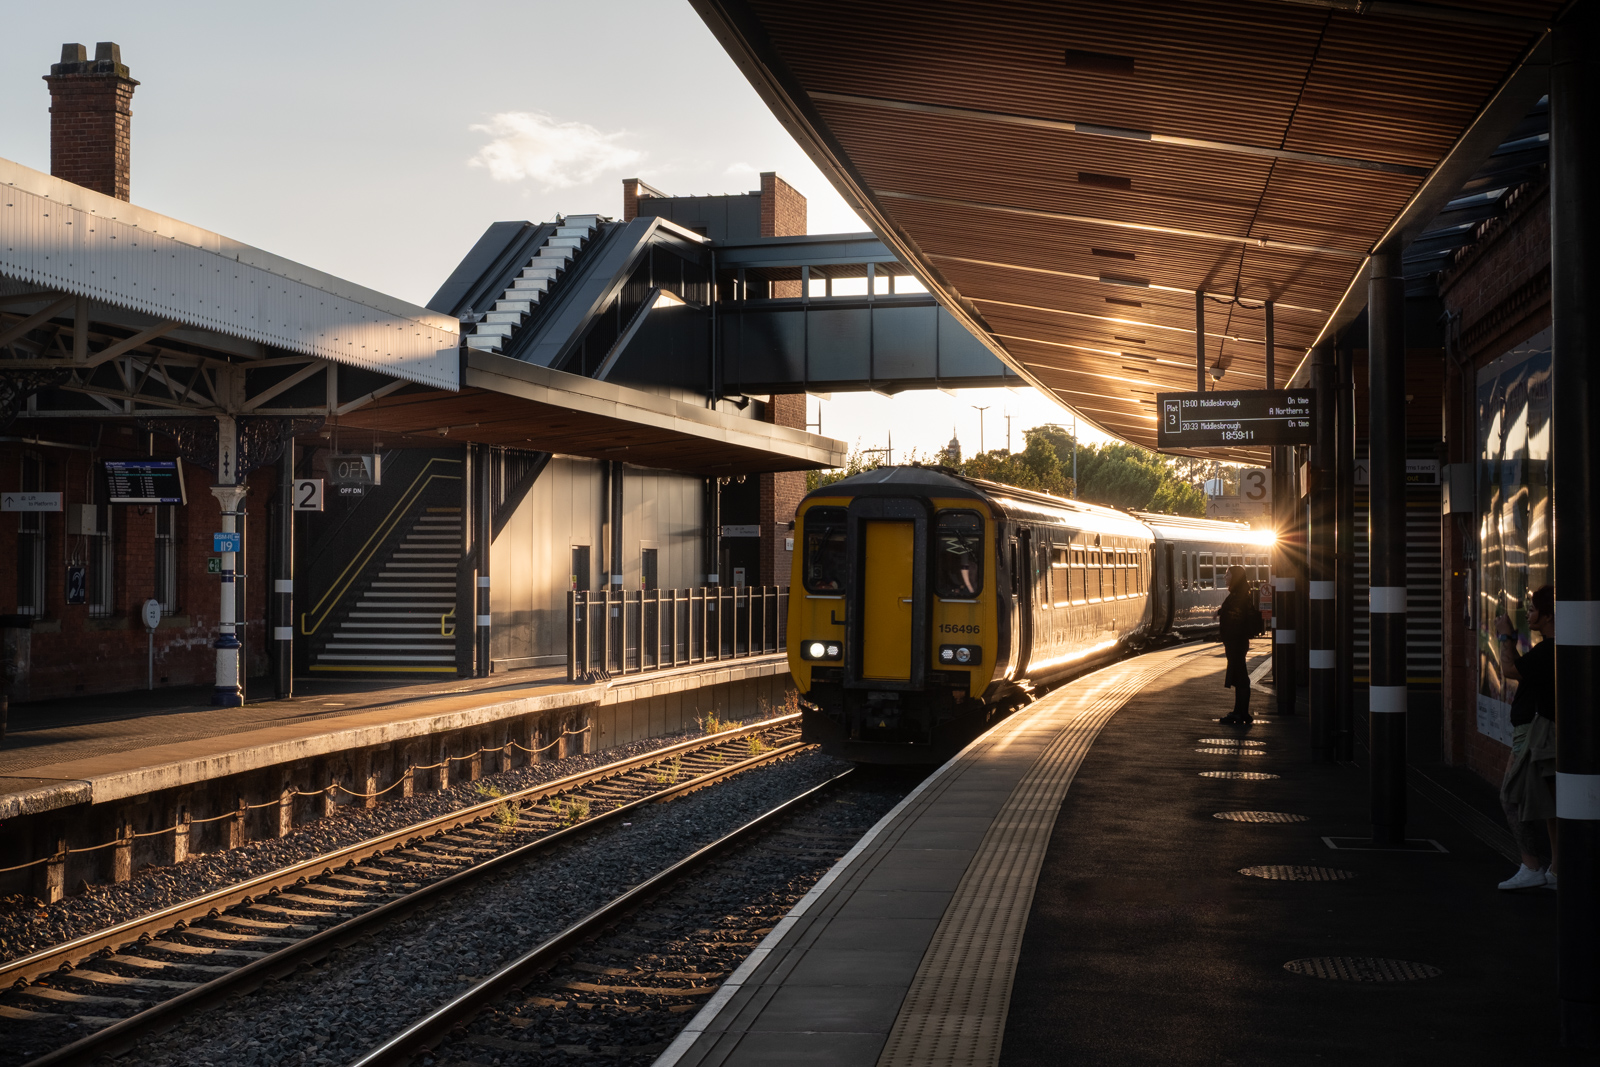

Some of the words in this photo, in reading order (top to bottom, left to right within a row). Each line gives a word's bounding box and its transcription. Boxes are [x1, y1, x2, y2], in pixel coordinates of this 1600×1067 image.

[1182, 399, 1198, 408] 19:00
[1200, 398, 1241, 409] Middlesbrough
[1287, 396, 1296, 404] On
[1297, 396, 1310, 404] time
[1166, 404, 1179, 412] Plat
[1275, 407, 1304, 415] Northern
[1169, 414, 1176, 425] 3
[1182, 422, 1199, 431] 20:33
[1200, 421, 1241, 431] Middlesbrough
[1287, 420, 1296, 428] On
[1221, 430, 1254, 440] 18:59:11
[1246, 471, 1267, 500] 3
[299, 481, 316, 508] 2
[220, 541, 233, 551] 119
[938, 624, 980, 634] 156496
